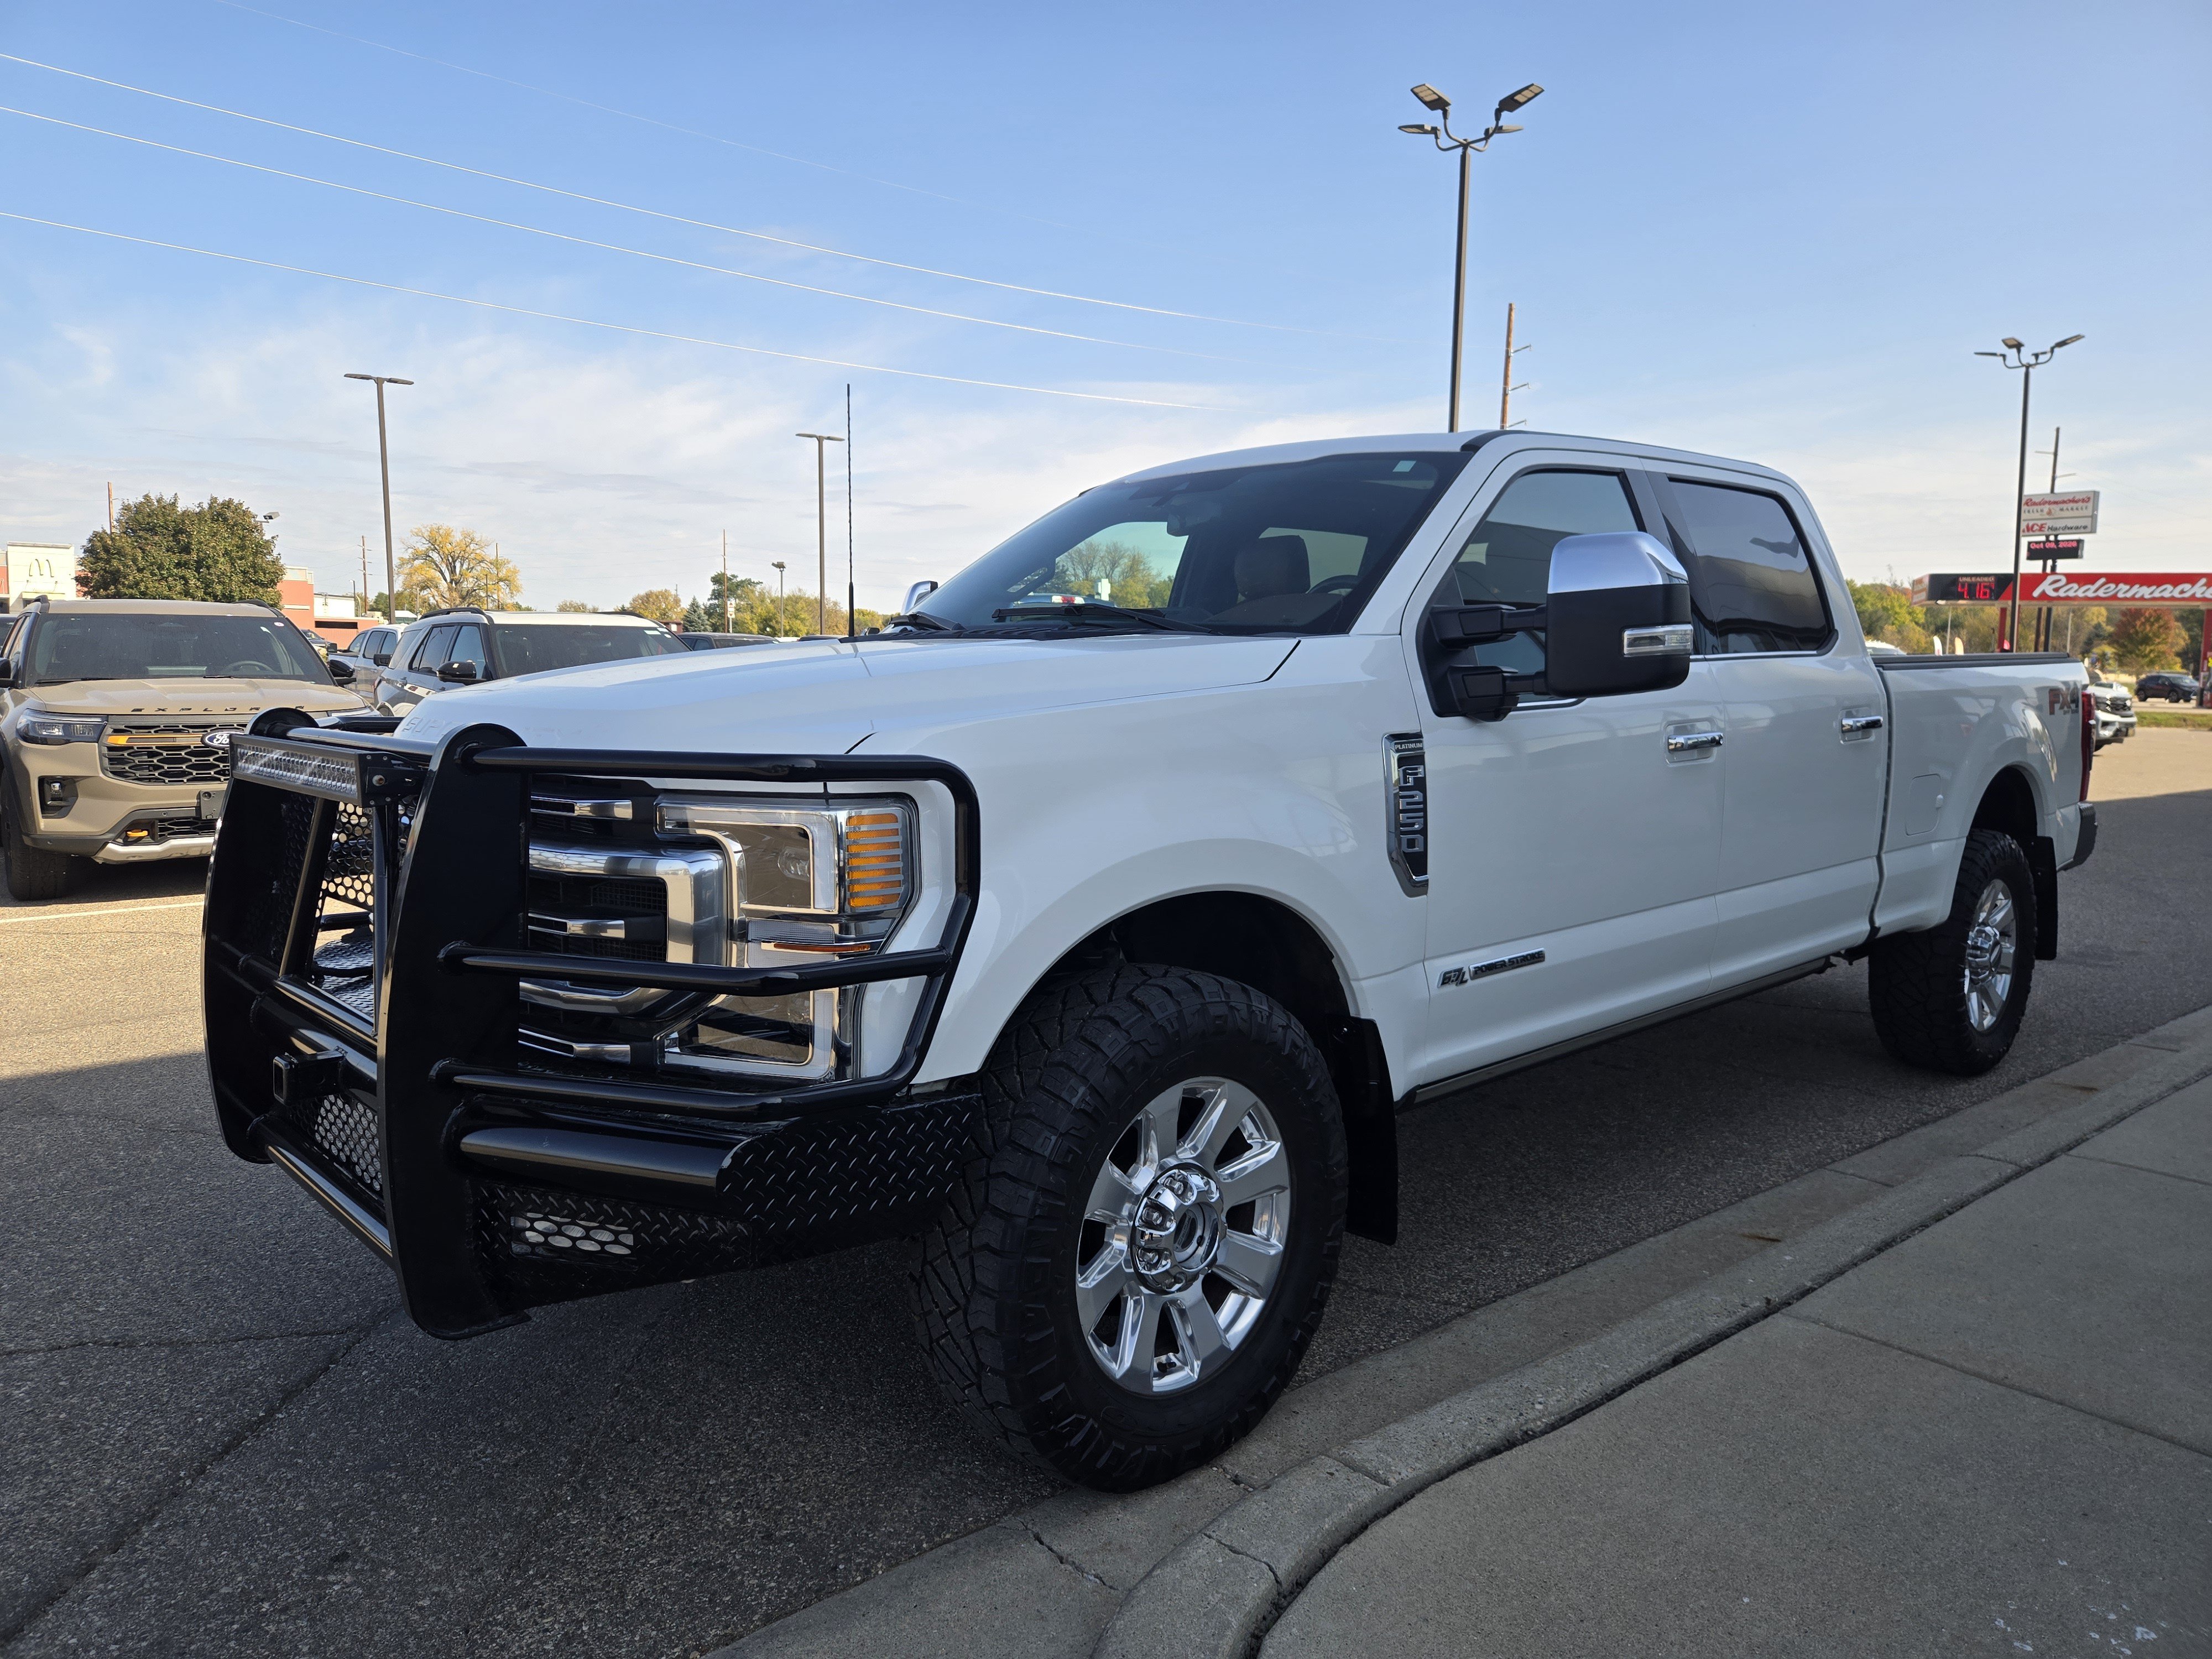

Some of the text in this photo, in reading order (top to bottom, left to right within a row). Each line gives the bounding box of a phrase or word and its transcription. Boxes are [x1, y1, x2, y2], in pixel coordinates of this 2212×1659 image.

[2022, 523, 2047, 533] ACE
[2049, 682, 2079, 715] FX4
[213, 733, 230, 744] Fo
[1507, 950, 1545, 967] STROKE
